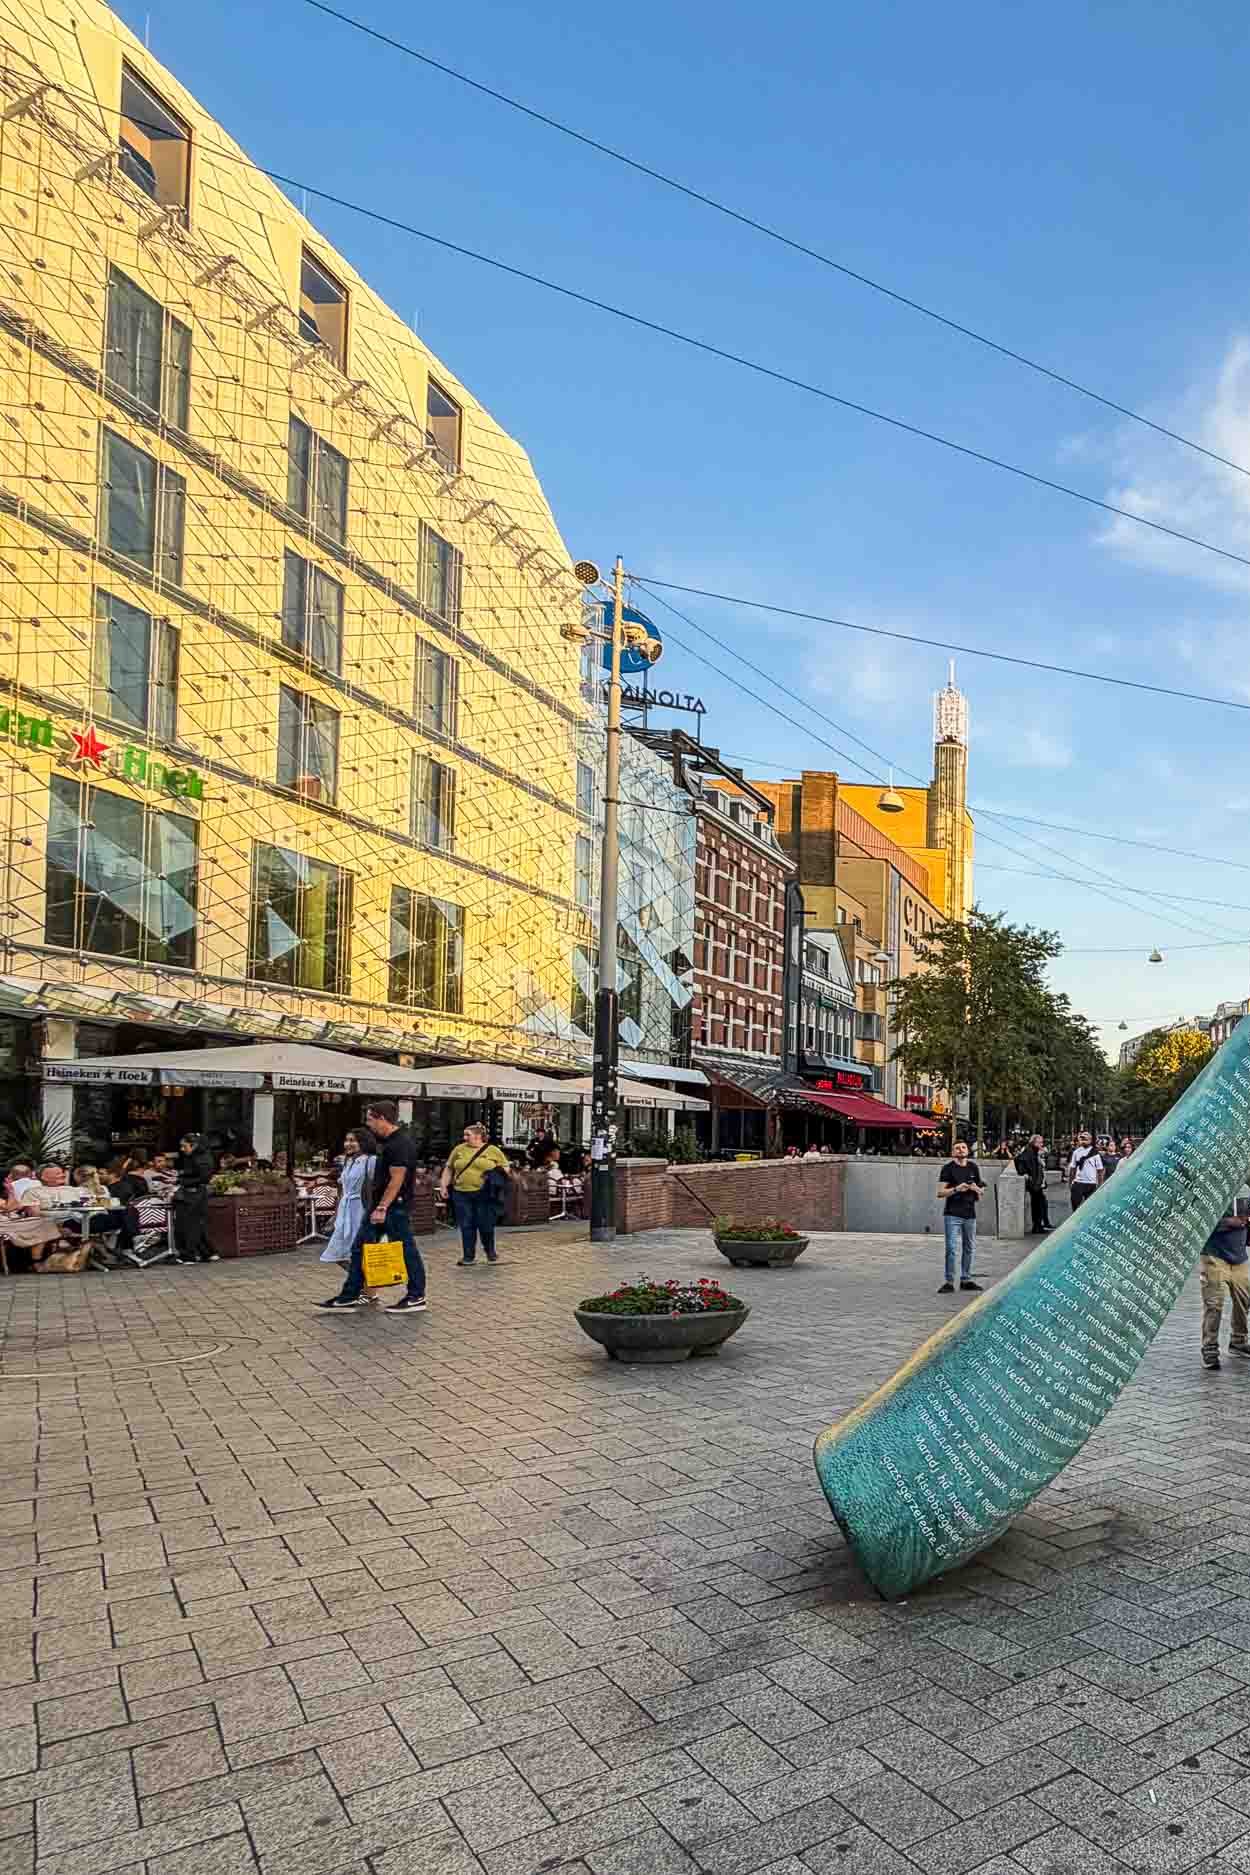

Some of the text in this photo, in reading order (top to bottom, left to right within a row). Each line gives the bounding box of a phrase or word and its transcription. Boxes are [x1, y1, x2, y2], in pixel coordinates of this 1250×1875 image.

[46, 1066, 101, 1080] Heineken
[279, 1075, 316, 1088] Heineken
[1130, 1247, 1148, 1267] Dan
[1019, 1333, 1053, 1364] quando
[1004, 1365, 1034, 1395] Vedrai
[1034, 1393, 1052, 1411] che
[926, 1392, 955, 1431] слабых
[912, 1433, 941, 1474] Maradj
